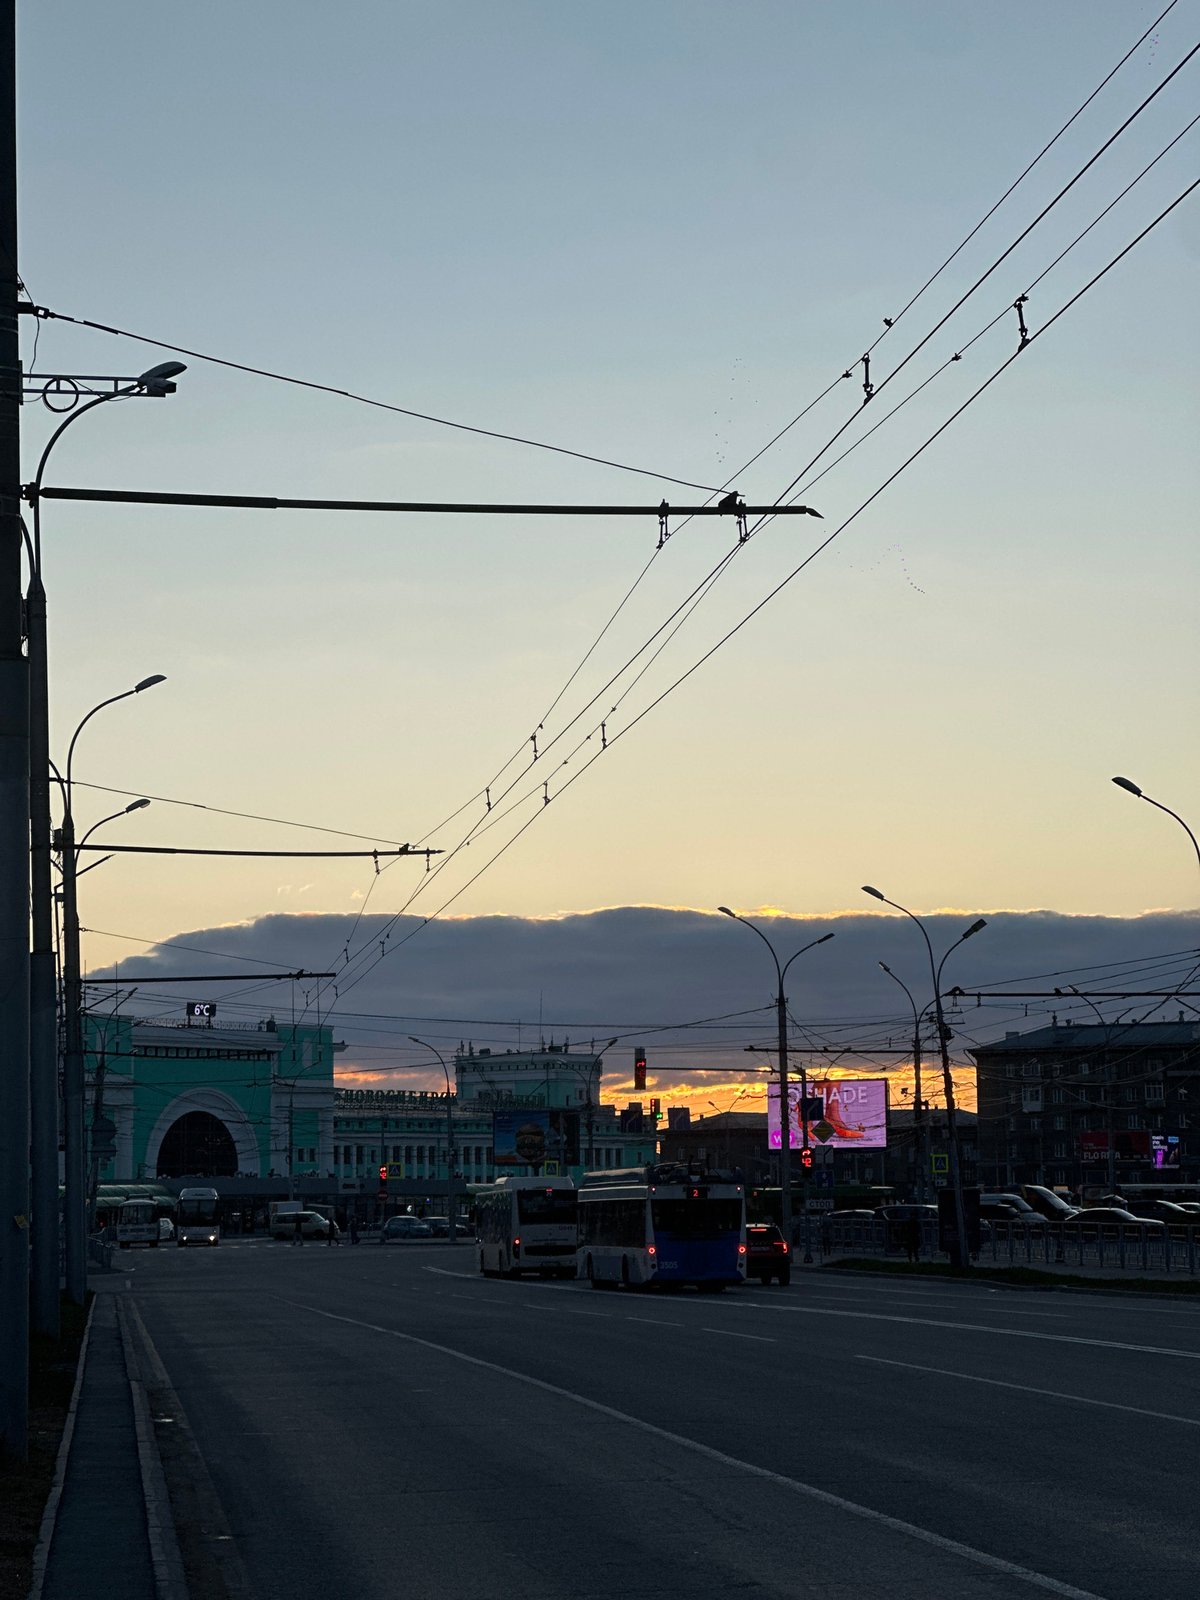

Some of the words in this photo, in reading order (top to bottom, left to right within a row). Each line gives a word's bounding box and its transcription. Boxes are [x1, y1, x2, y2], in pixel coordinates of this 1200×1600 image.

[194, 1004, 210, 1016] 6°C
[692, 1189, 699, 1197] 2
[809, 1200, 831, 1208] СТОП
